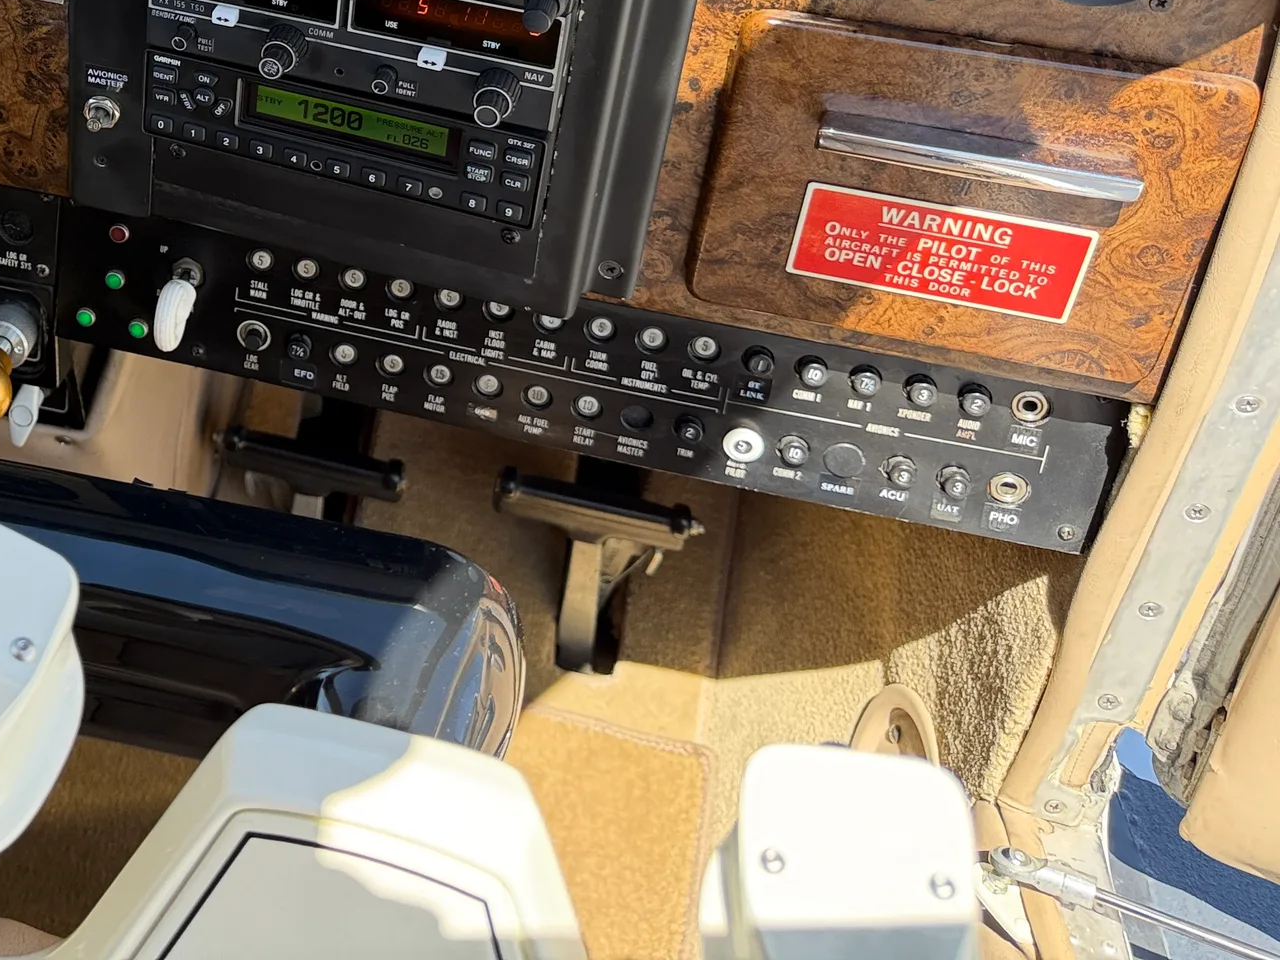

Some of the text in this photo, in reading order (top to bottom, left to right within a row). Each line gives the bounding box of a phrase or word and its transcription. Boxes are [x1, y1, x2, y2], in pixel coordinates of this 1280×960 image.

[308, 27, 334, 39] COMM
[154, 55, 181, 66] GARMIN
[87, 68, 128, 82] AVIONICS
[524, 72, 544, 83] NAV
[87, 75, 124, 89] MASTER
[196, 93, 209, 103] ALT
[298, 98, 363, 132] 1200
[376, 117, 445, 138] PRESSURE ALT
[508, 138, 536, 149] GTX 327
[470, 146, 492, 157] FUNC
[505, 155, 529, 167] CRSR
[505, 178, 521, 189] CLR
[882, 206, 1013, 246] WARNING
[878, 233, 907, 248] THE
[917, 237, 982, 262] PILOT
[990, 254, 1011, 267] OF
[1021, 259, 1056, 275] THIS
[824, 236, 1048, 286] AIRCRAFT IS PERMITTED TO
[824, 248, 1038, 300] OPEN CLOSE LOCK
[883, 273, 970, 298] THIS DOOR
[449, 351, 486, 366] ELECTRICAL
[294, 368, 314, 380] EFD
[621, 377, 667, 393] INSTRUMENTS
[739, 390, 764, 401] LINK
[1011, 433, 1038, 447] MIC
[677, 448, 694, 458] TRIM
[820, 482, 854, 495] SPARE
[879, 490, 904, 501] ACU
[989, 510, 1018, 525] PHO
